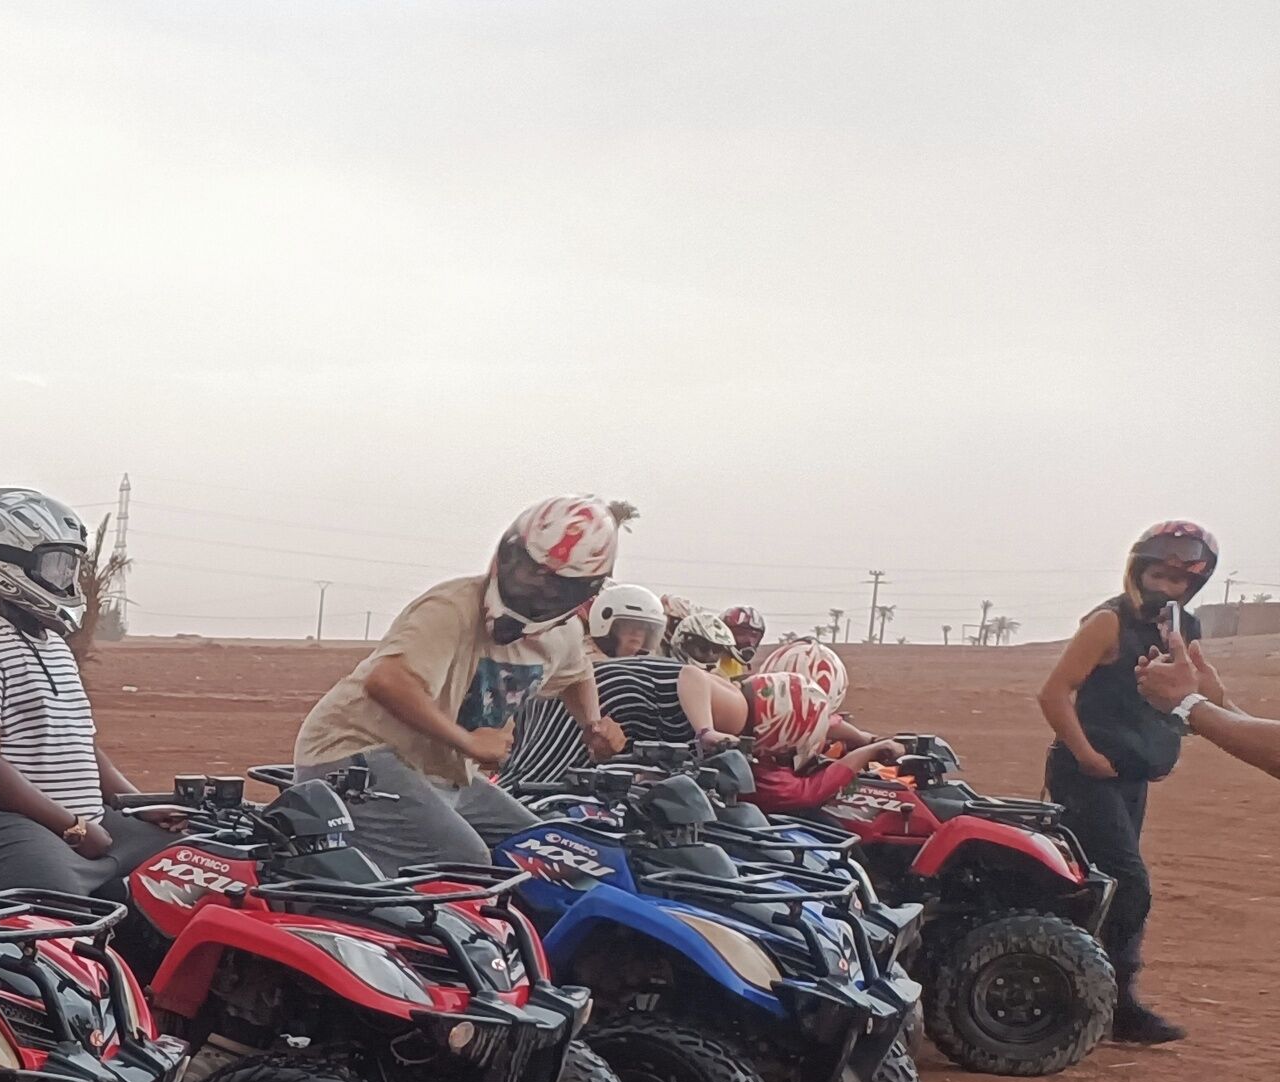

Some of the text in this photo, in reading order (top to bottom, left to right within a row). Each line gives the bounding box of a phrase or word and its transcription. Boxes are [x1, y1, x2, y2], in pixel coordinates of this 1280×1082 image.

[559, 838, 598, 857] KYMCO
[191, 854, 230, 873] KYMCO
[515, 838, 616, 877] MXU
